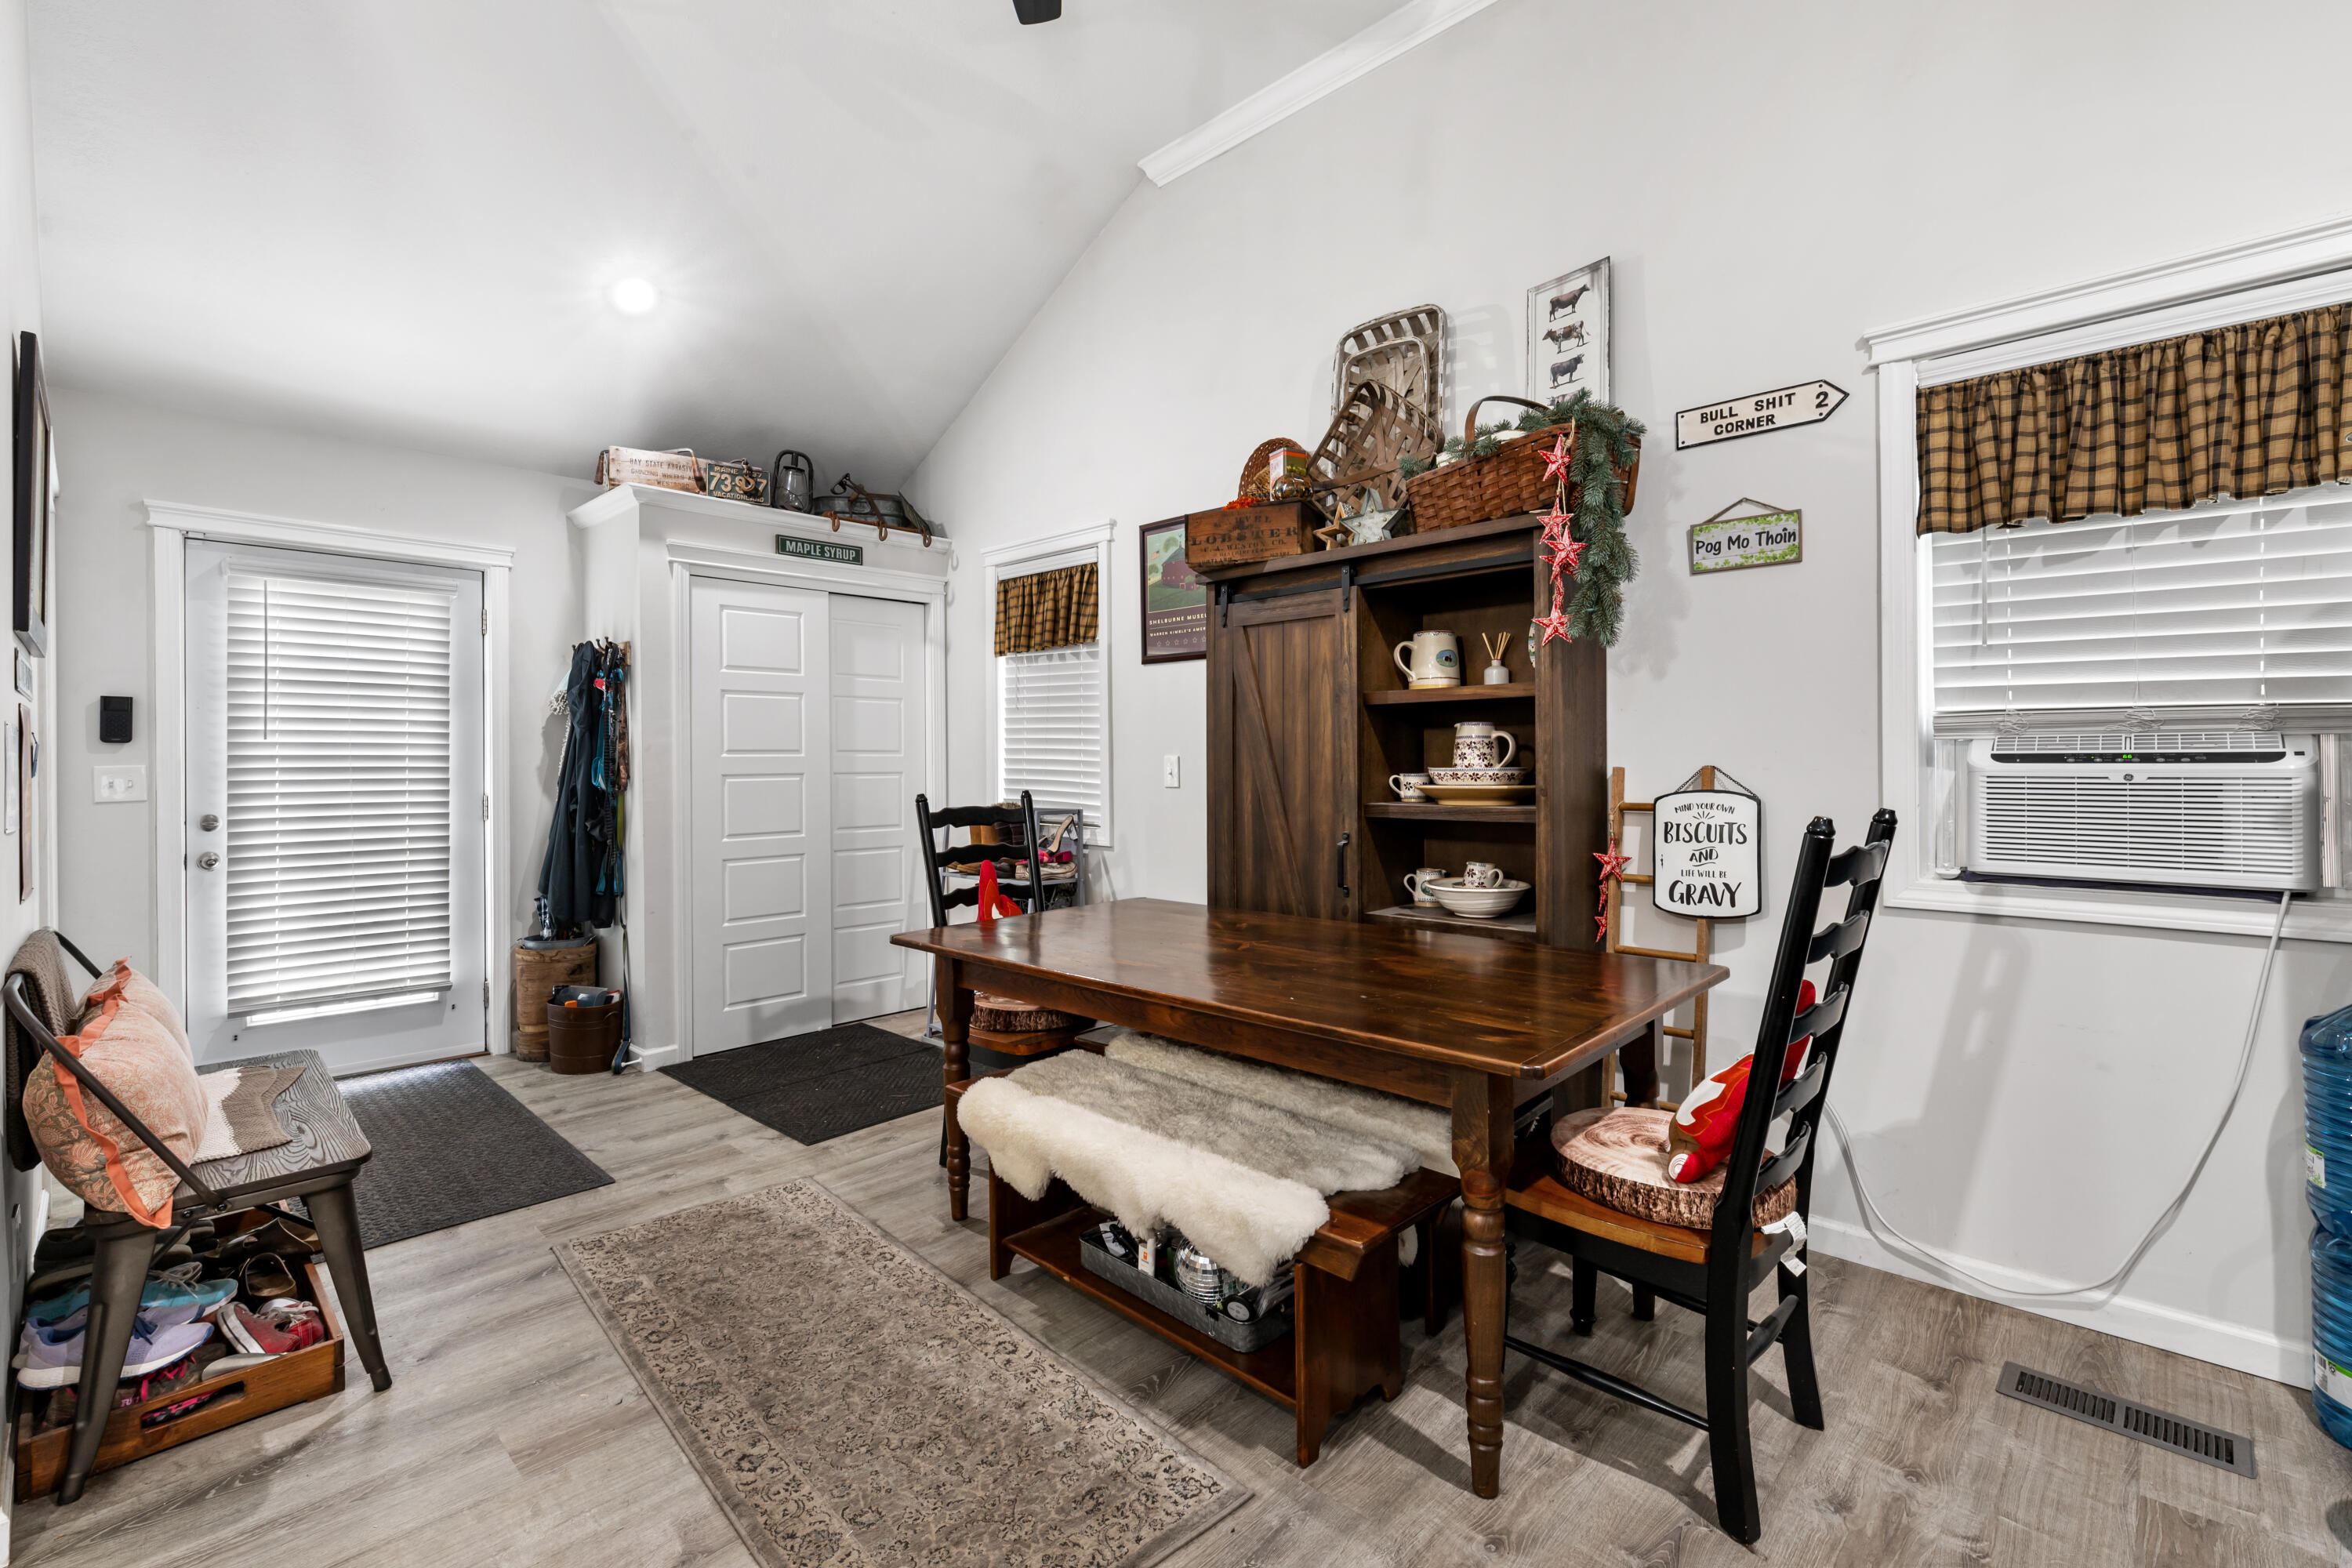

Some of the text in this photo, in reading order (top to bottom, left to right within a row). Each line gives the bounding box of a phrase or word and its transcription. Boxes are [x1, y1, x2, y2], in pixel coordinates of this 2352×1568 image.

[1700, 392, 1796, 424] BULL SHIT
[1815, 390, 1829, 409] 2
[1714, 414, 1777, 436] CORNER
[645, 459, 664, 469] STATE
[713, 466, 739, 475] MAINE
[709, 471, 768, 496] 73-97
[713, 491, 764, 503] VACATIONLAND
[786, 540, 856, 561] MAPLE SYRUP
[1696, 540, 1722, 556] Pog
[1727, 534, 1750, 550] Mo
[1149, 616, 1185, 626] SHELBURNE
[1674, 803, 1694, 814] MIND
[1715, 804, 1735, 815] OWN
[1663, 821, 1748, 845] BISCUITS
[1689, 848, 1719, 863] AND
[1681, 869, 1727, 879] LIFE WILL BE
[1668, 880, 1742, 909] GRAVY
